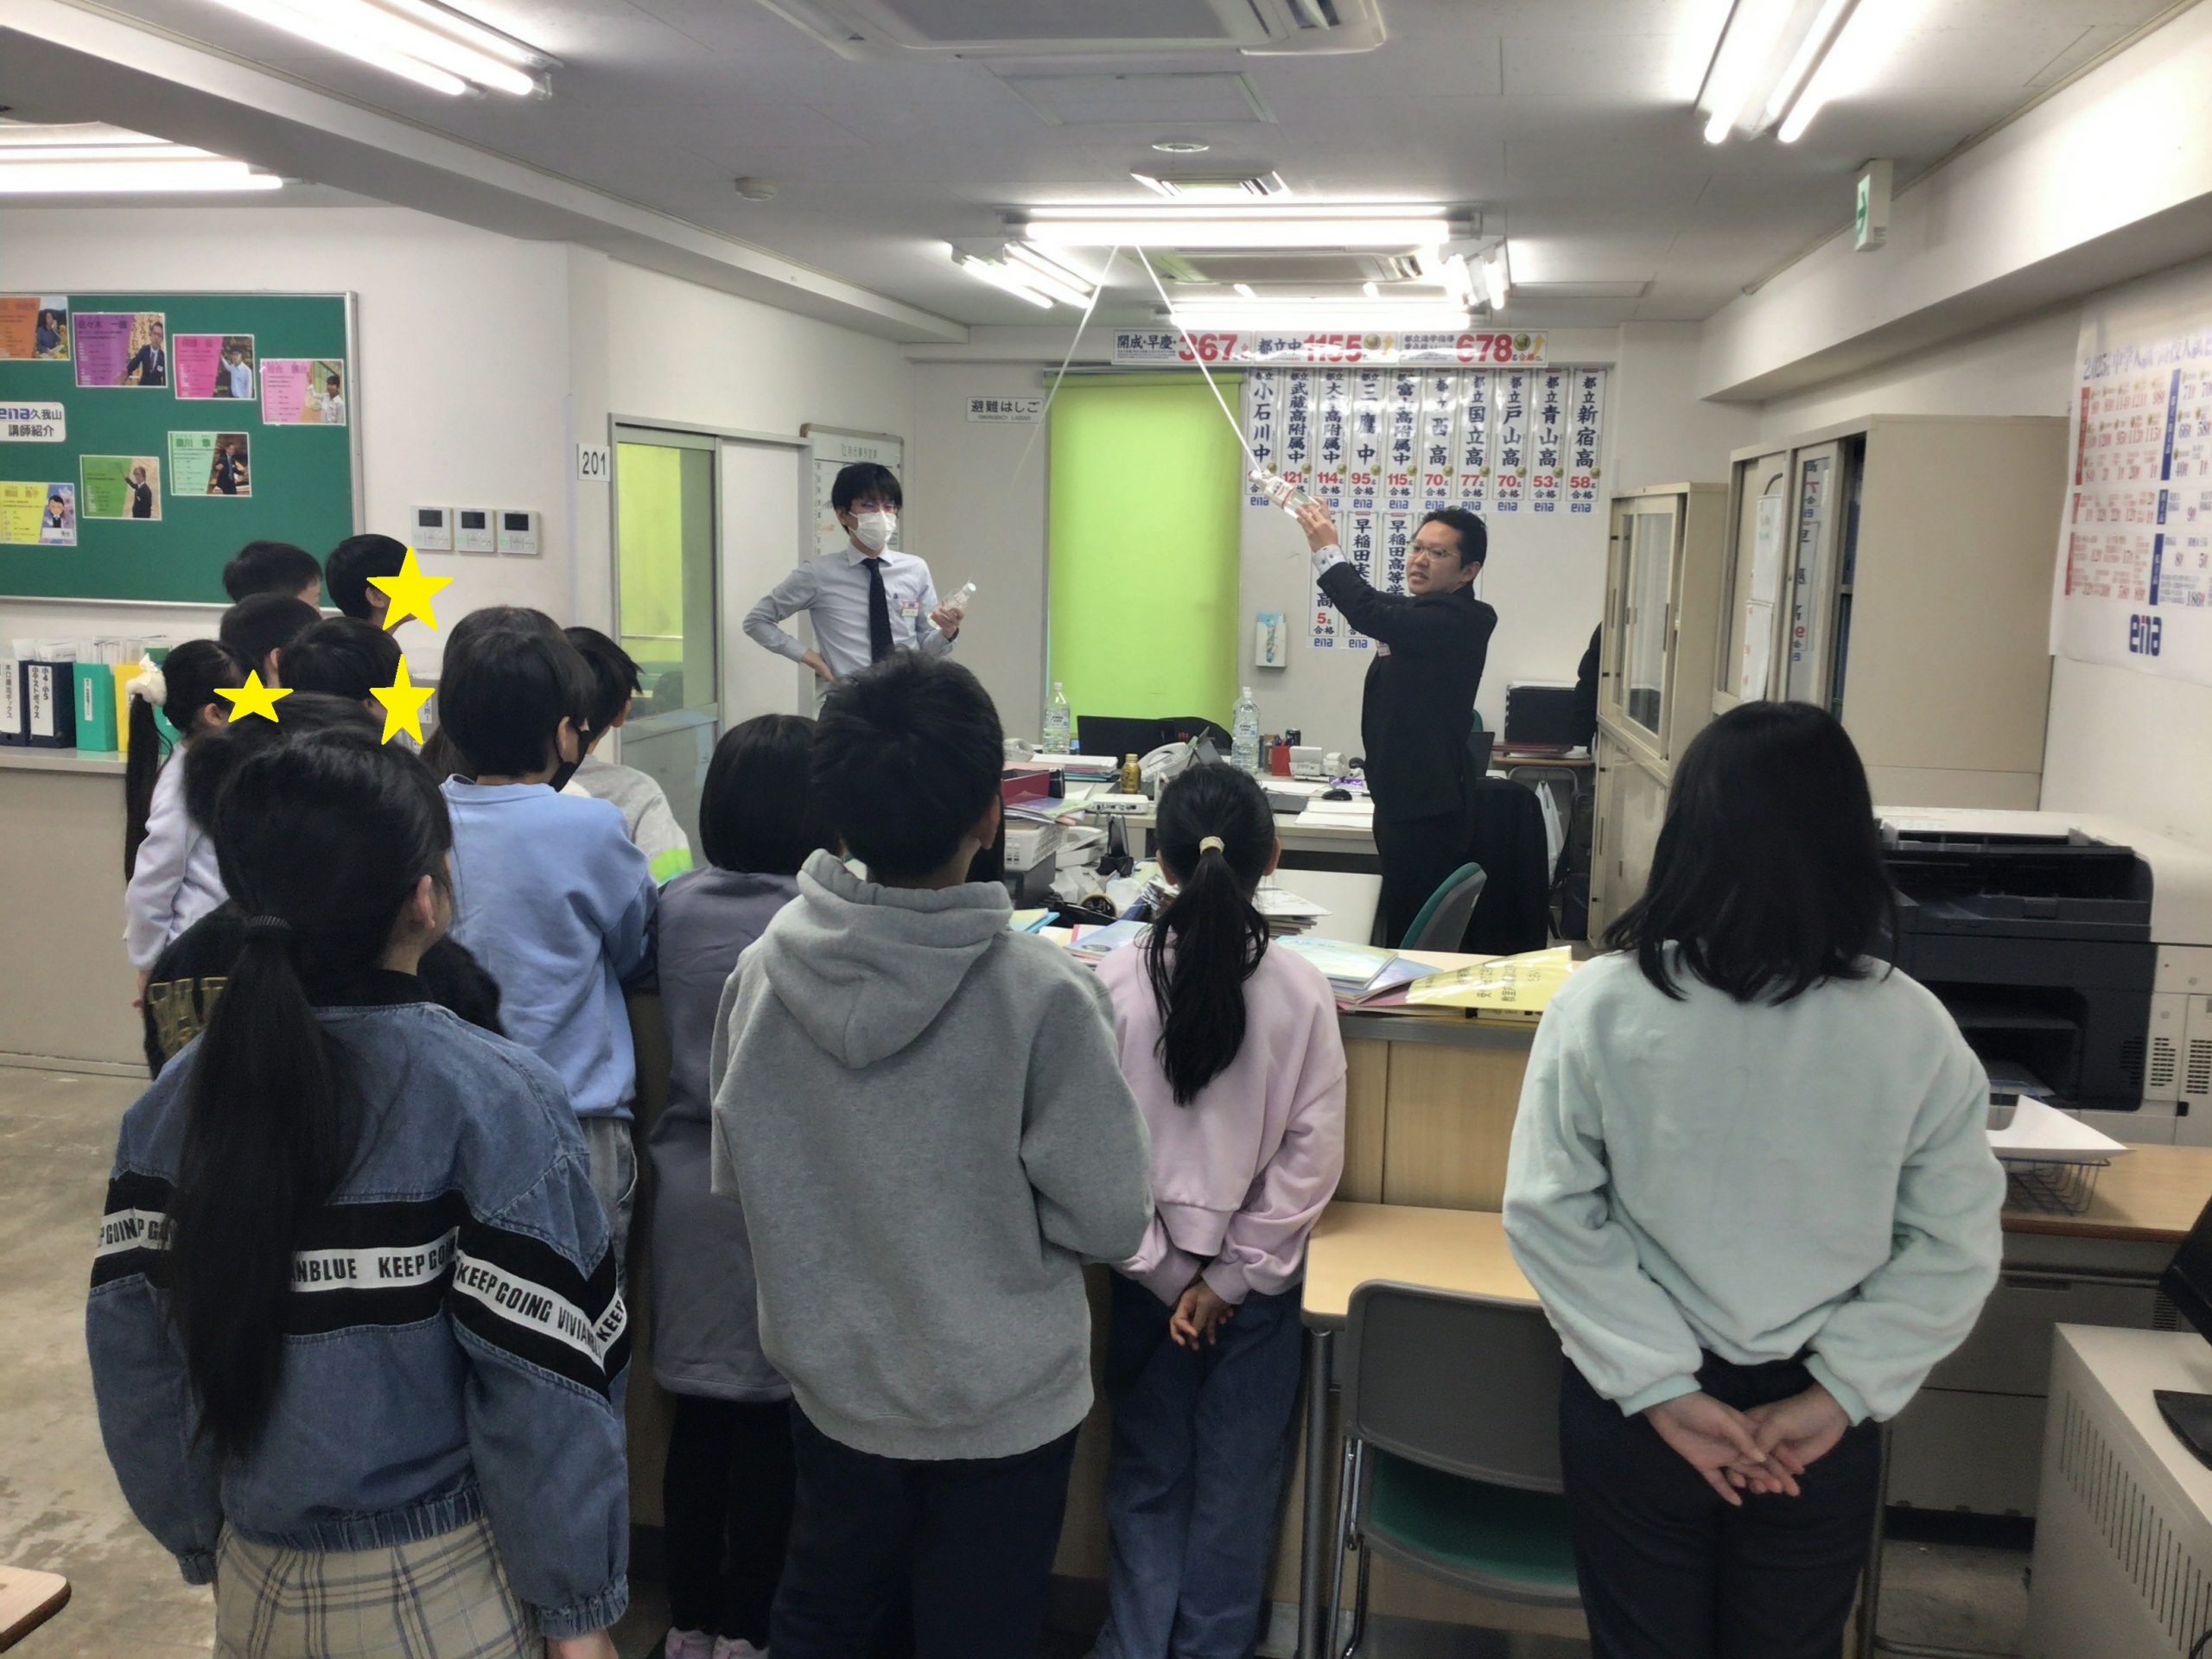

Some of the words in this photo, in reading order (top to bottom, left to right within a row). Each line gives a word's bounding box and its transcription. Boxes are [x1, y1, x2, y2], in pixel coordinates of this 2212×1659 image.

[1179, 333, 1237, 361] 367
[1456, 334, 1512, 362] 678
[970, 399, 1039, 413] 避難はしご
[1253, 381, 1273, 462] 小石川中
[1287, 381, 1308, 464] 武蔵高附属中
[1392, 383, 1415, 466] 富高附属中
[1465, 375, 1486, 467] 都立国立高
[1503, 376, 1522, 467] 都立戸山高
[1539, 376, 1560, 467] 都立青山高
[1575, 376, 1599, 468] 都立新宿高
[8, 424, 54, 437] 講師紹介
[582, 451, 607, 474] 201
[1319, 486, 1340, 494] 合格
[1354, 486, 1374, 495] 合格
[1389, 487, 1410, 496] 合格
[1425, 488, 1446, 497] 合格
[1461, 488, 1482, 498] 合格
[1497, 489, 1519, 498] 合格
[1534, 490, 1555, 499] 合格
[1571, 490, 1593, 499] 合格
[1250, 497, 1269, 506] ena
[1326, 499, 1338, 507] na
[1353, 499, 1372, 508] ena
[1389, 499, 1408, 509] ena
[1425, 500, 1445, 510] ena
[1461, 501, 1481, 511] ena
[1497, 502, 1517, 512] ena
[1534, 502, 1554, 512] ena
[1571, 503, 1591, 512] ena
[1313, 626, 1334, 634] 合格
[2129, 613, 2162, 656] ena
[1314, 638, 1333, 647] ena
[1349, 639, 1368, 648] ena
[378, 1254, 425, 1279] KEEP
[456, 1262, 498, 1294] KEEP
[495, 1282, 553, 1324] GOING
[595, 1300, 625, 1343] KEEP
